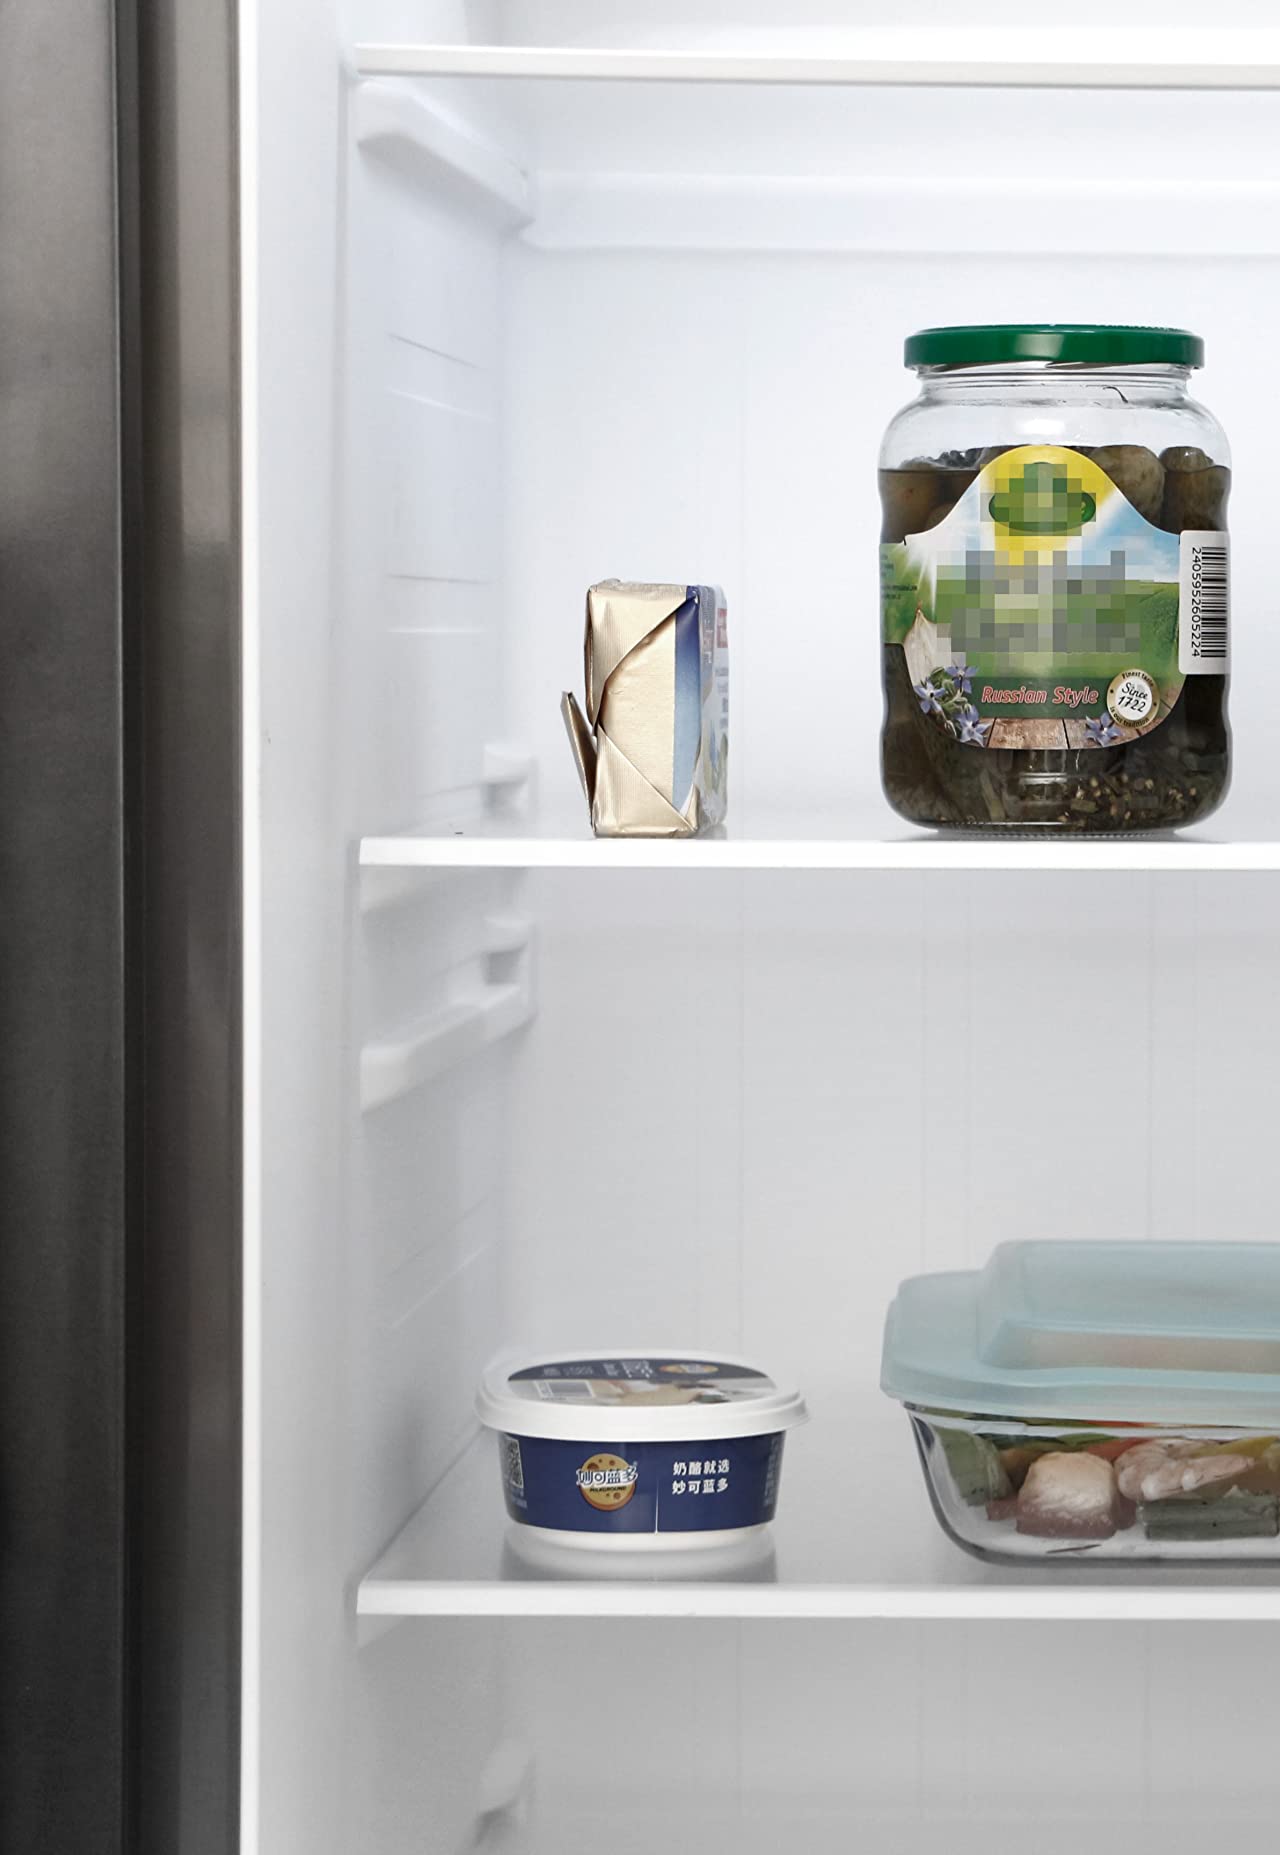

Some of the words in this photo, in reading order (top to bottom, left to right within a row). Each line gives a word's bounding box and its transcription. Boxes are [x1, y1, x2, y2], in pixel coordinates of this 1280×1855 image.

[1191, 547, 1201, 657] 2405952605224
[981, 685, 1047, 703] Russian
[1052, 686, 1099, 708] Style
[1121, 681, 1148, 700] Since
[1117, 695, 1146, 713] 1722
[672, 1458, 730, 1476] 奶酪就选
[672, 1477, 729, 1495] 妙可蓝多
